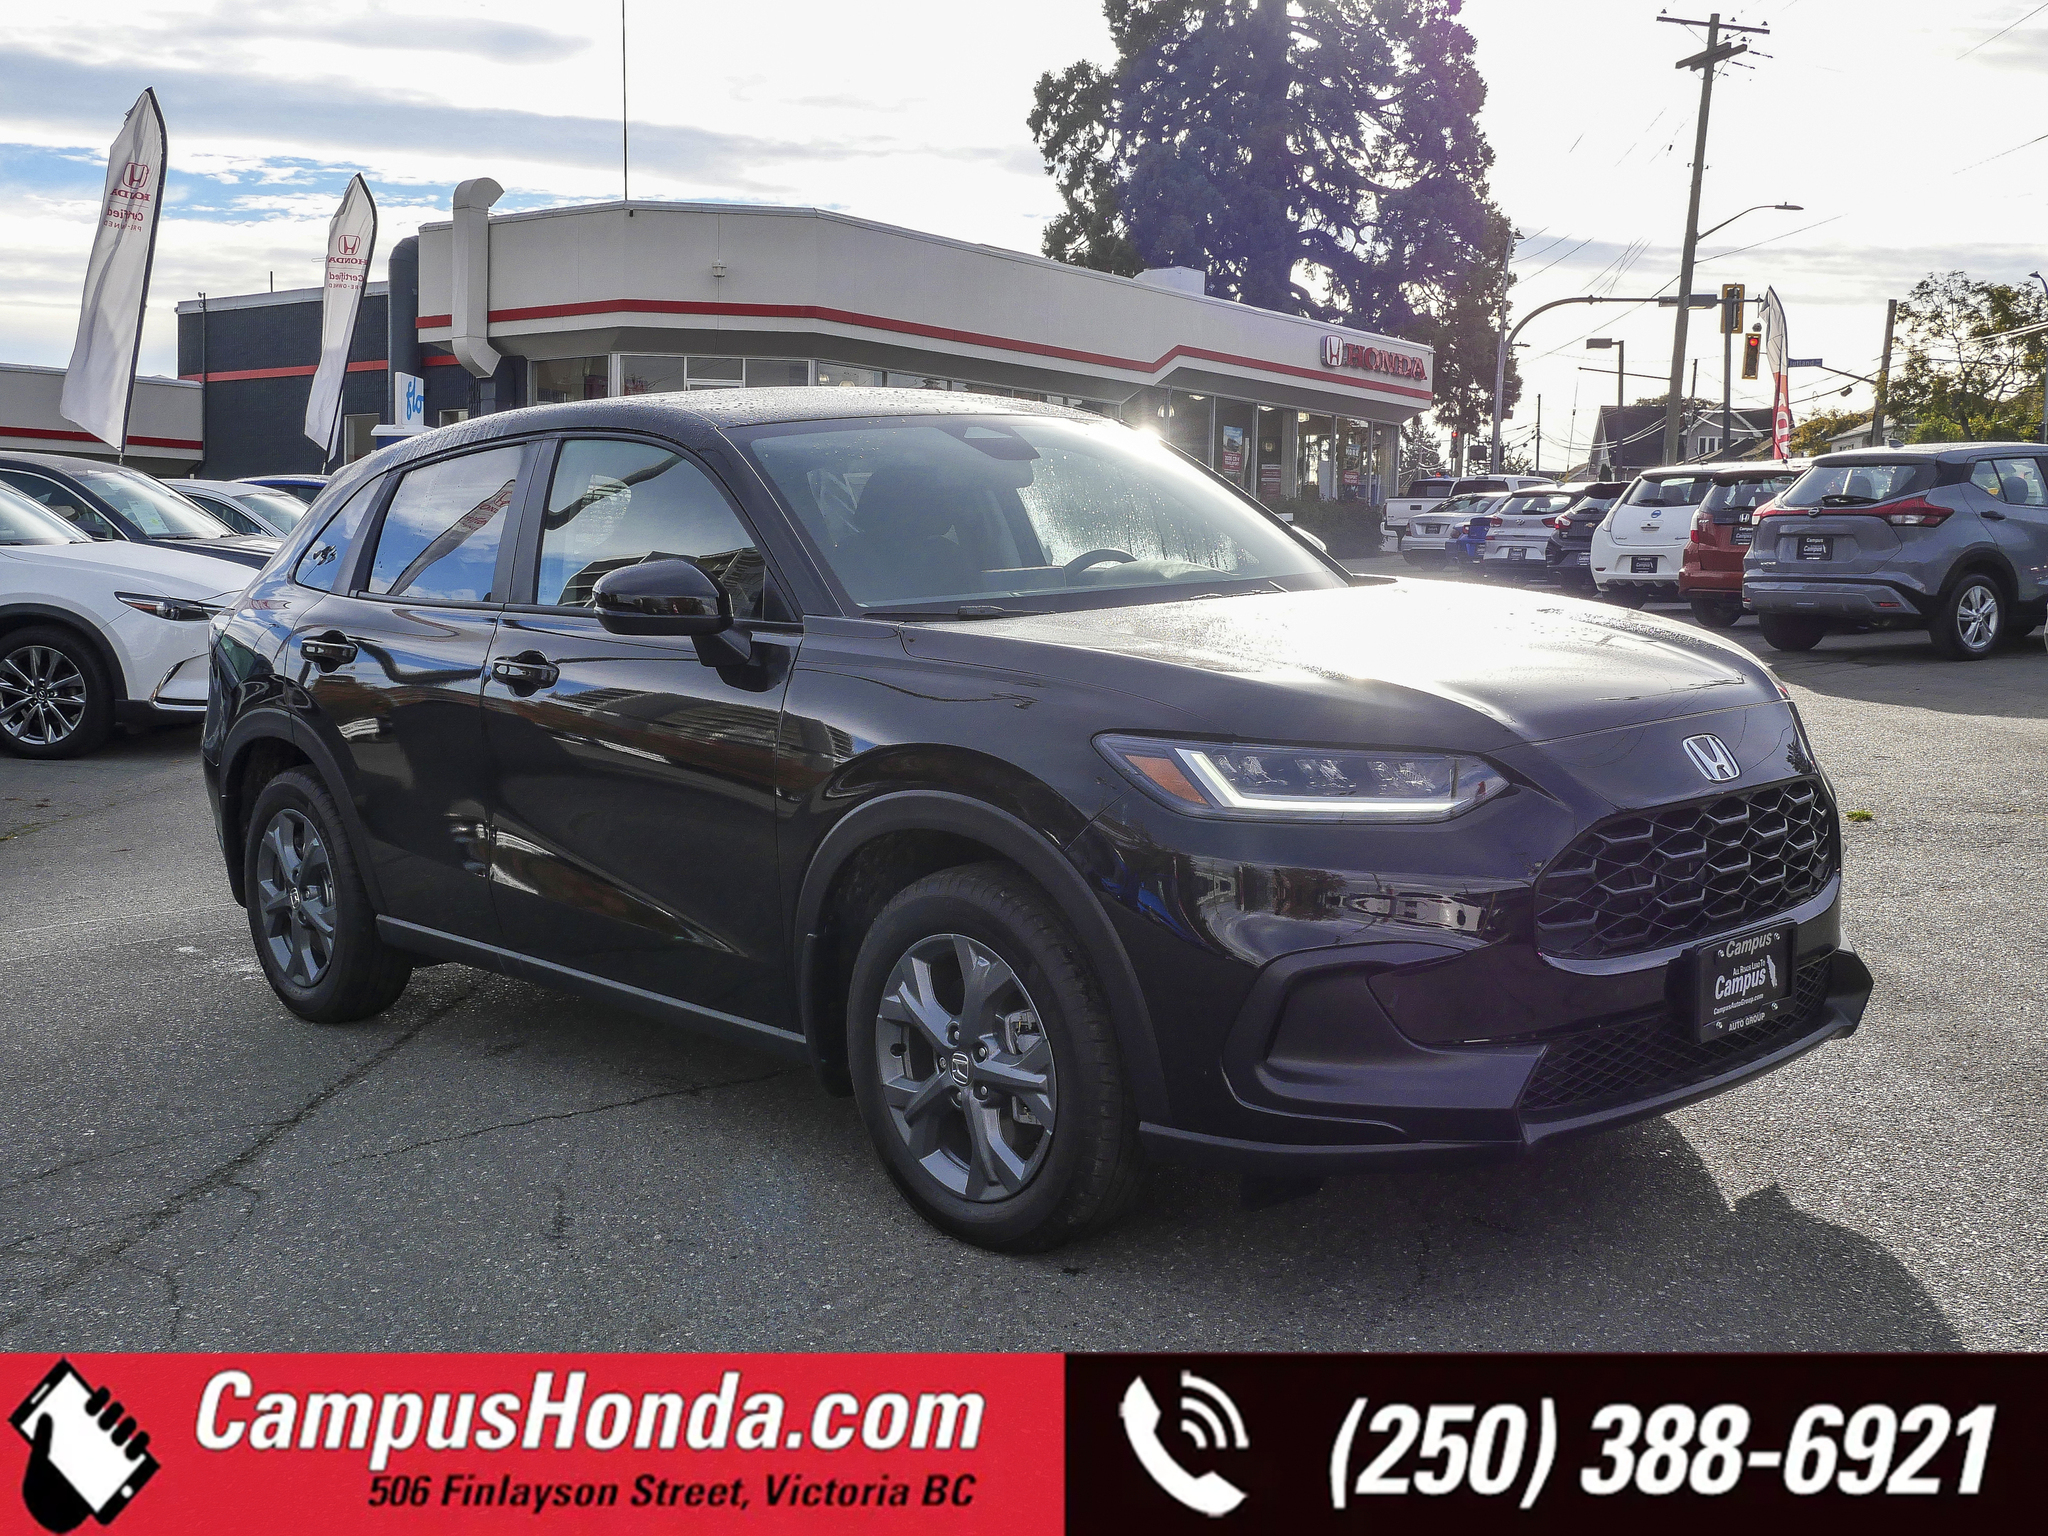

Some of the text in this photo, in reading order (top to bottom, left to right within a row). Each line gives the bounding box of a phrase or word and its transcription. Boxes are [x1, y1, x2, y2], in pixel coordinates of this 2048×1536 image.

[1346, 343, 1427, 380] HONDA
[406, 377, 425, 420] flo
[1726, 932, 1772, 957] Campus
[1715, 968, 1766, 1000] Campus
[1713, 993, 1764, 1015] CampusAutoGroup.com
[1728, 1012, 1766, 1032] AUTO GROUP
